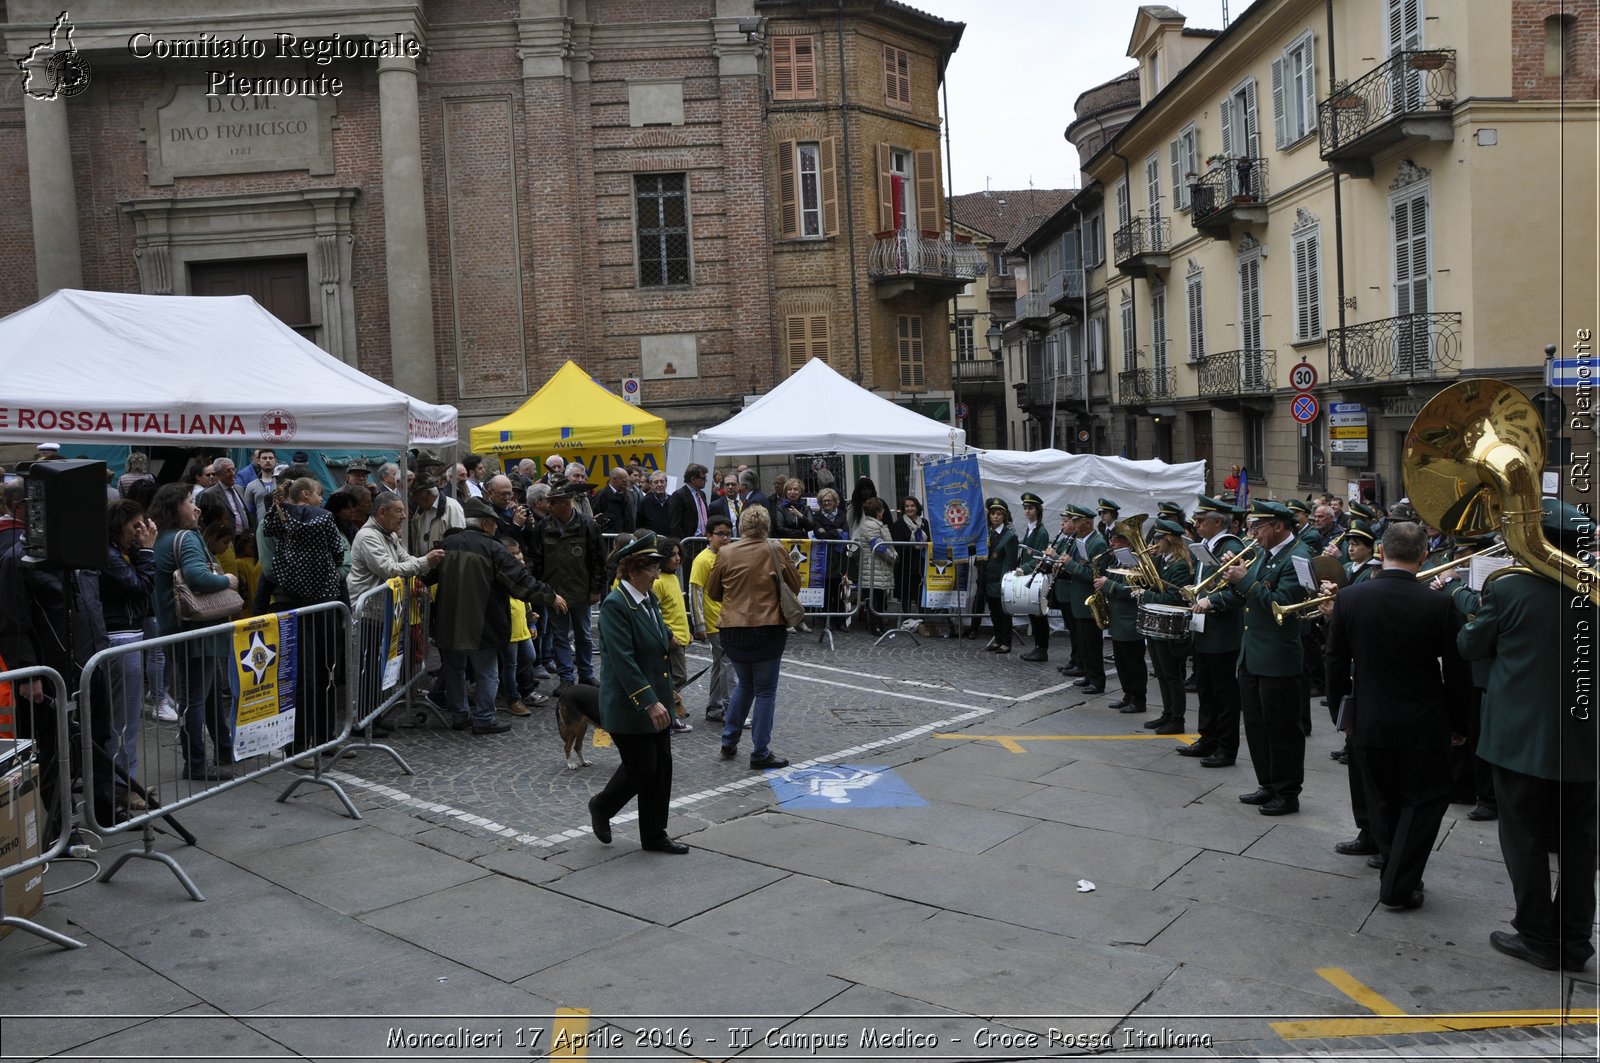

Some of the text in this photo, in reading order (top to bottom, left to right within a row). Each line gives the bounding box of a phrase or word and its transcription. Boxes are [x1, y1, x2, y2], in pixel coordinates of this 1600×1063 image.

[170, 120, 308, 142] DIVO FRANCISCO
[1296, 371, 1312, 385] 30
[18, 409, 113, 432] ROSSA
[121, 412, 246, 435] ITALIANA
[553, 441, 583, 449] AVIVA
